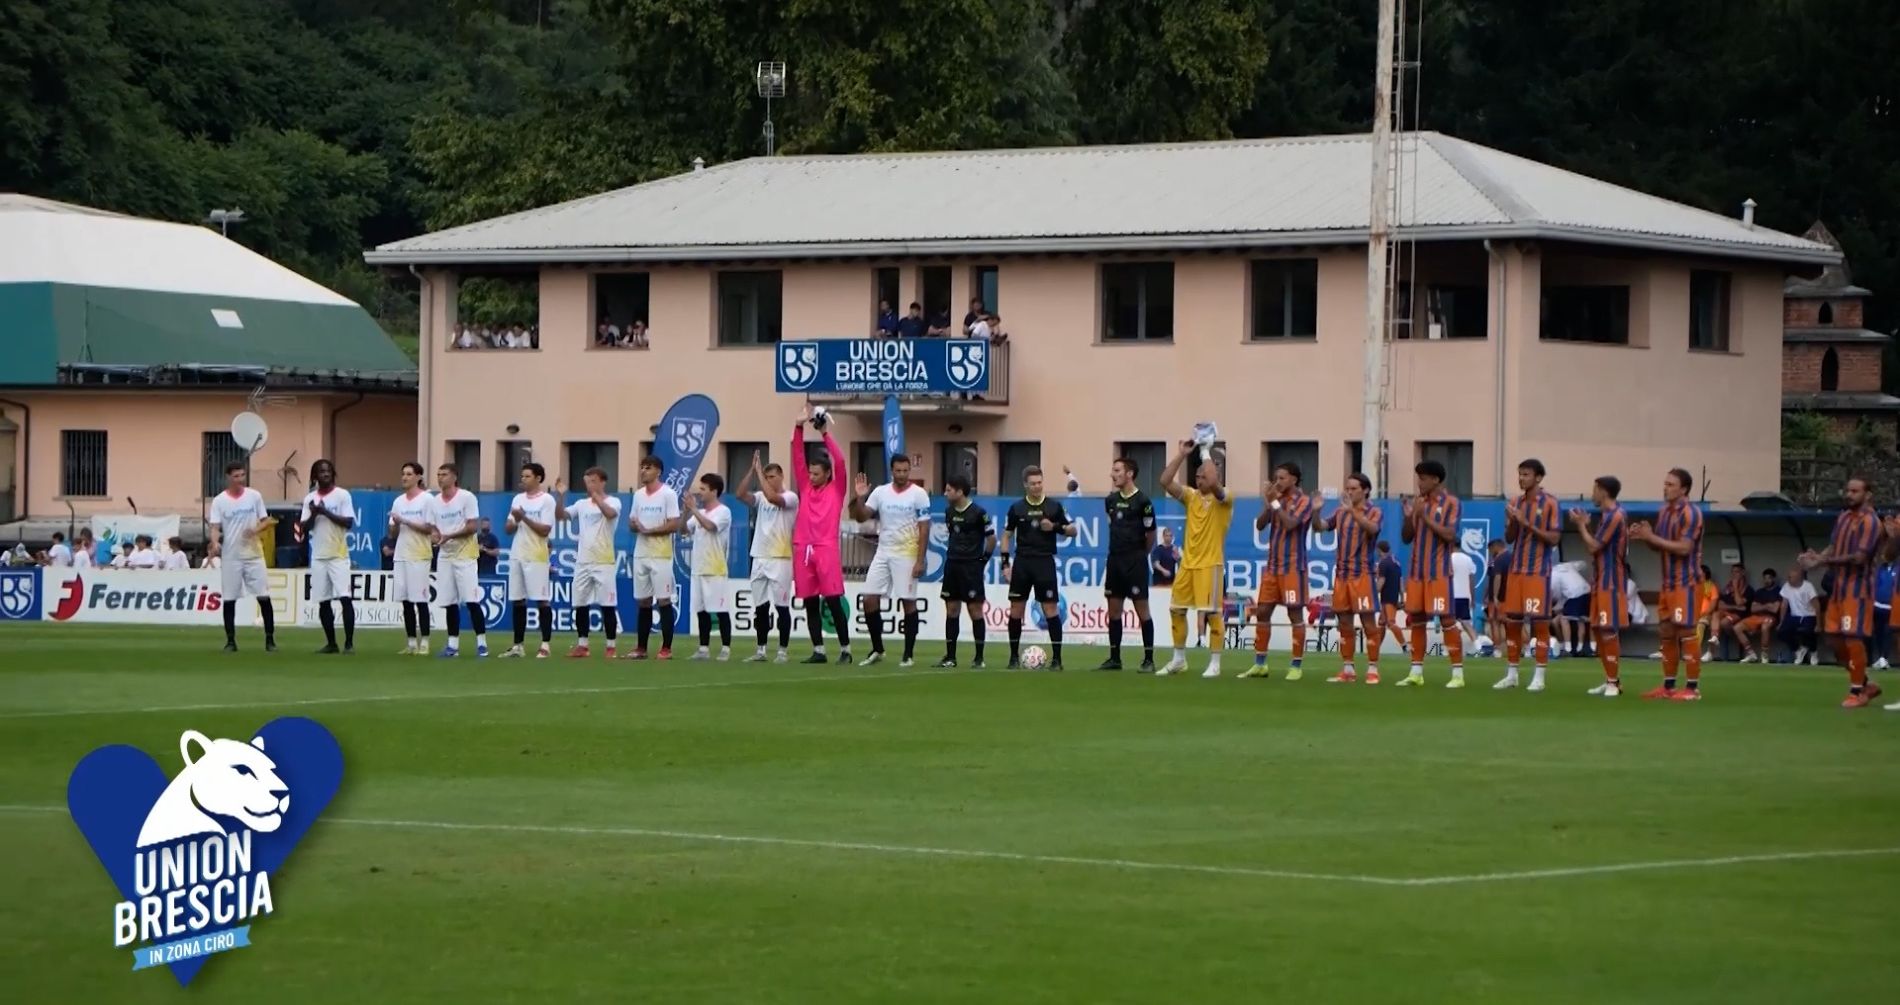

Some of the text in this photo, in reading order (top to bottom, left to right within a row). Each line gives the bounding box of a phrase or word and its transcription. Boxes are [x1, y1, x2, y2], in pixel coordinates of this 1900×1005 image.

[849, 340, 914, 361] UNION
[835, 360, 928, 382] BRESCIA
[1285, 590, 1296, 604] 18
[1358, 597, 1370, 611] 14
[1433, 597, 1445, 611] 16
[1525, 598, 1540, 613] 82
[1599, 611, 1607, 626] 3
[1674, 607, 1683, 622] 6
